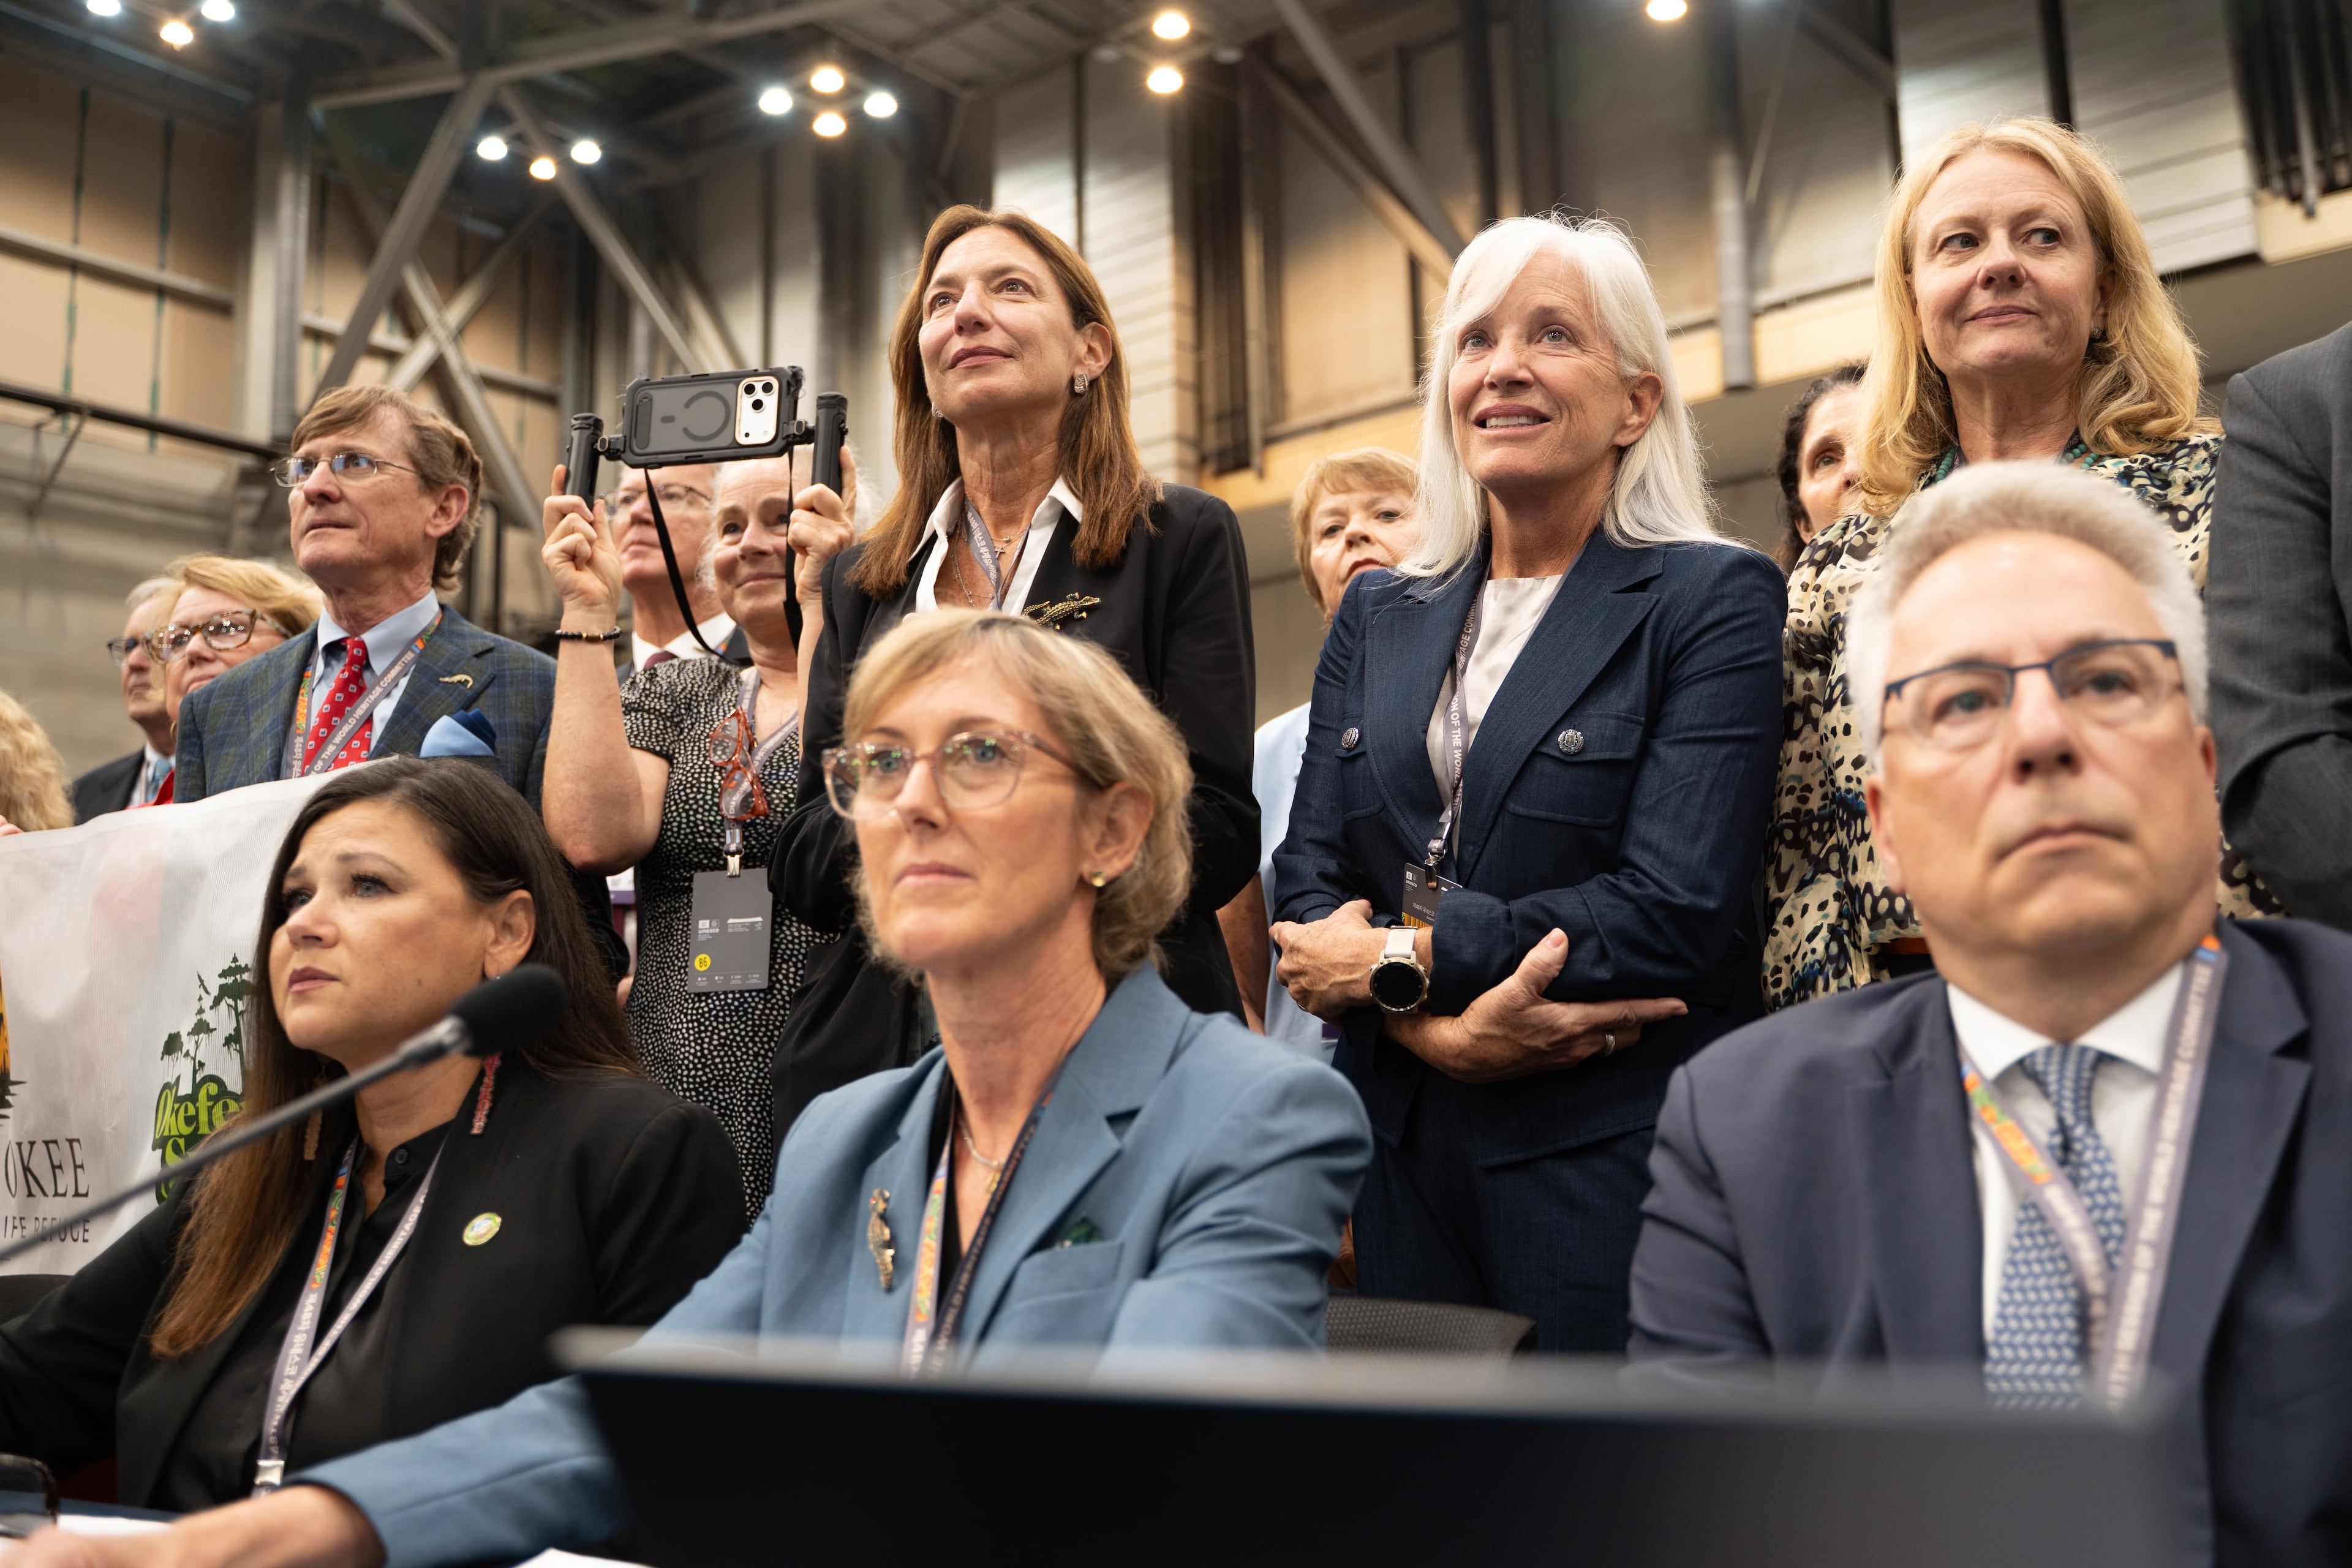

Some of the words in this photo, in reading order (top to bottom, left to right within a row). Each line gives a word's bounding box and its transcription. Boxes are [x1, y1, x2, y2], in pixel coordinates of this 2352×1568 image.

[1458, 635, 1471, 670] ERITAGE
[314, 760, 324, 771] OF
[321, 744, 336, 760] THE
[332, 717, 356, 744] WORLD
[353, 687, 383, 720] HERITAGE
[381, 650, 416, 688] COMMITTEE
[1450, 713, 1461, 726] OF
[1452, 727, 1461, 747] THE
[699, 957, 707, 968] 86
[155, 1081, 245, 1139] Okefe
[349, 1266, 383, 1311] WORLD
[381, 1205, 423, 1265] HERITAGE
[296, 1292, 318, 1331] 제48차
[284, 1332, 307, 1376] 유네스코
